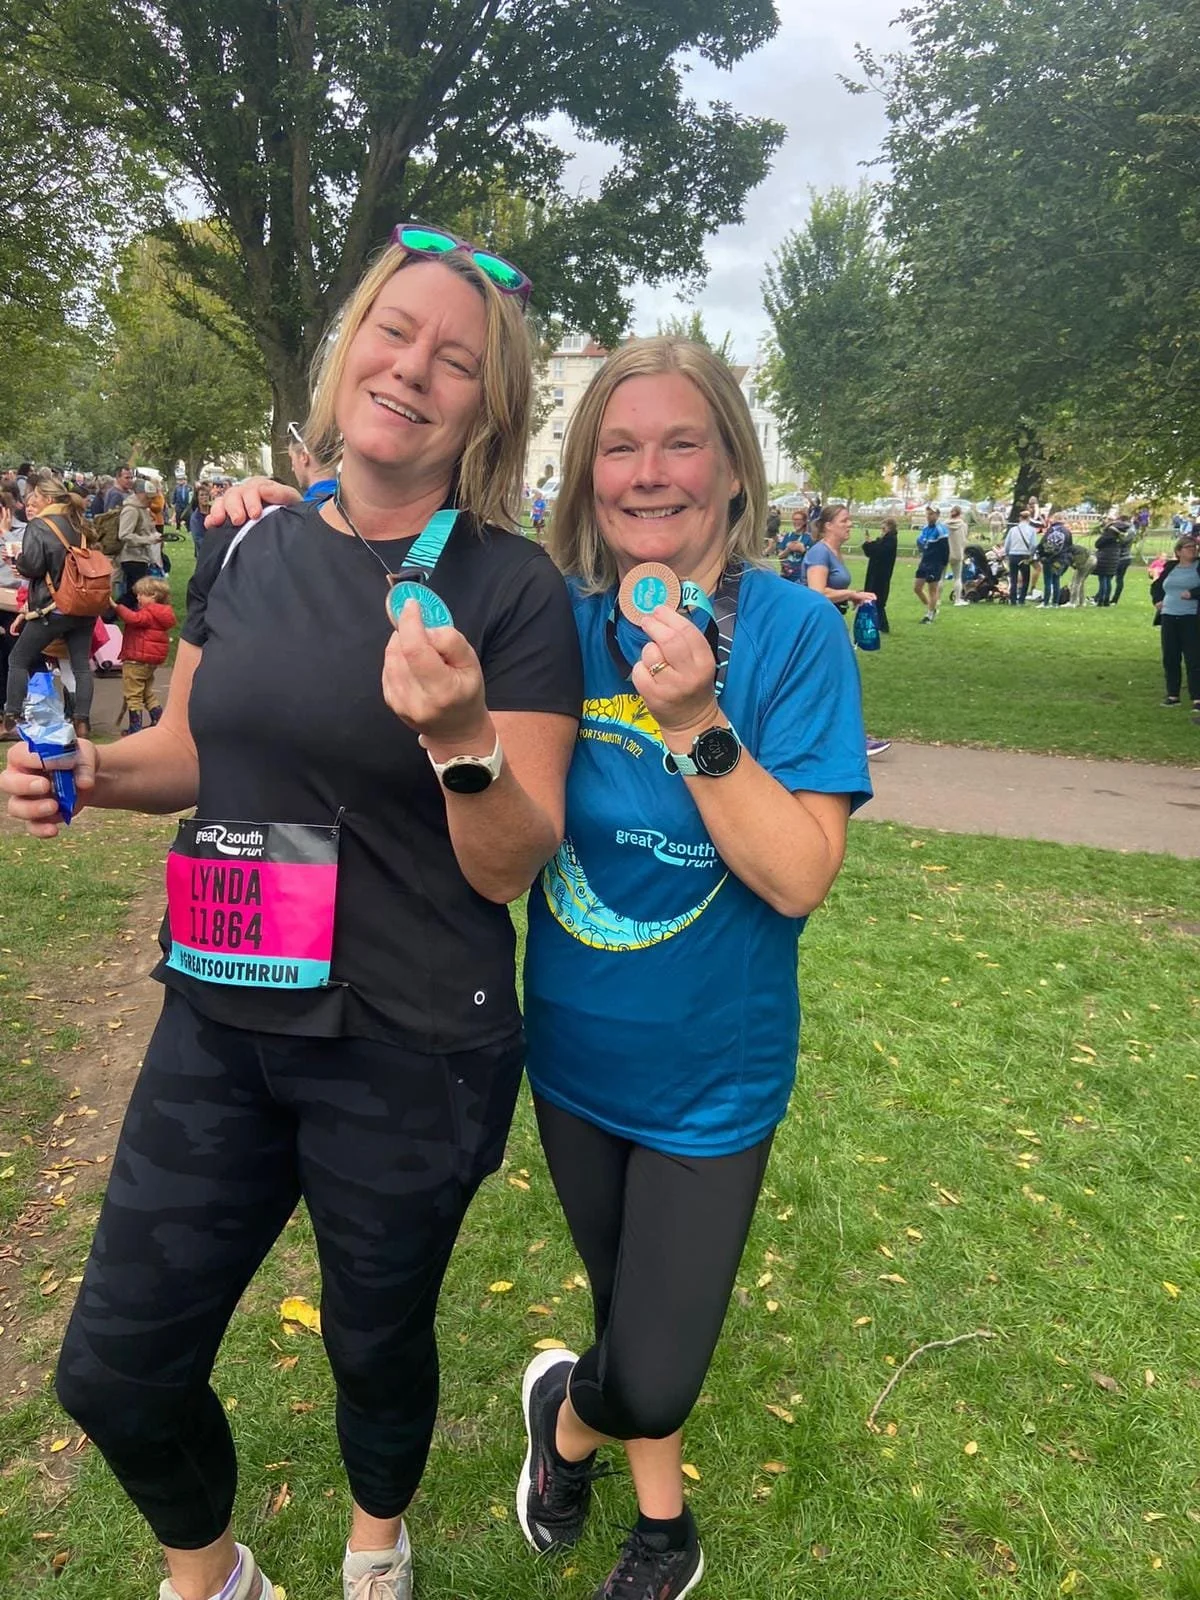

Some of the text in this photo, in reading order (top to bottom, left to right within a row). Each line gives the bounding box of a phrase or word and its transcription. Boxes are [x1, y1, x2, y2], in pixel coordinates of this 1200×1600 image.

[682, 586, 699, 601] 20
[579, 728, 644, 760] PORTSMOUTH 2022
[195, 829, 263, 845] great south
[615, 829, 715, 857] great south
[240, 847, 262, 857] run
[686, 858, 714, 868] run
[191, 864, 262, 906] LYNDA
[190, 907, 263, 950] 11864
[180, 950, 299, 984] #GREATSOUTHRUN
